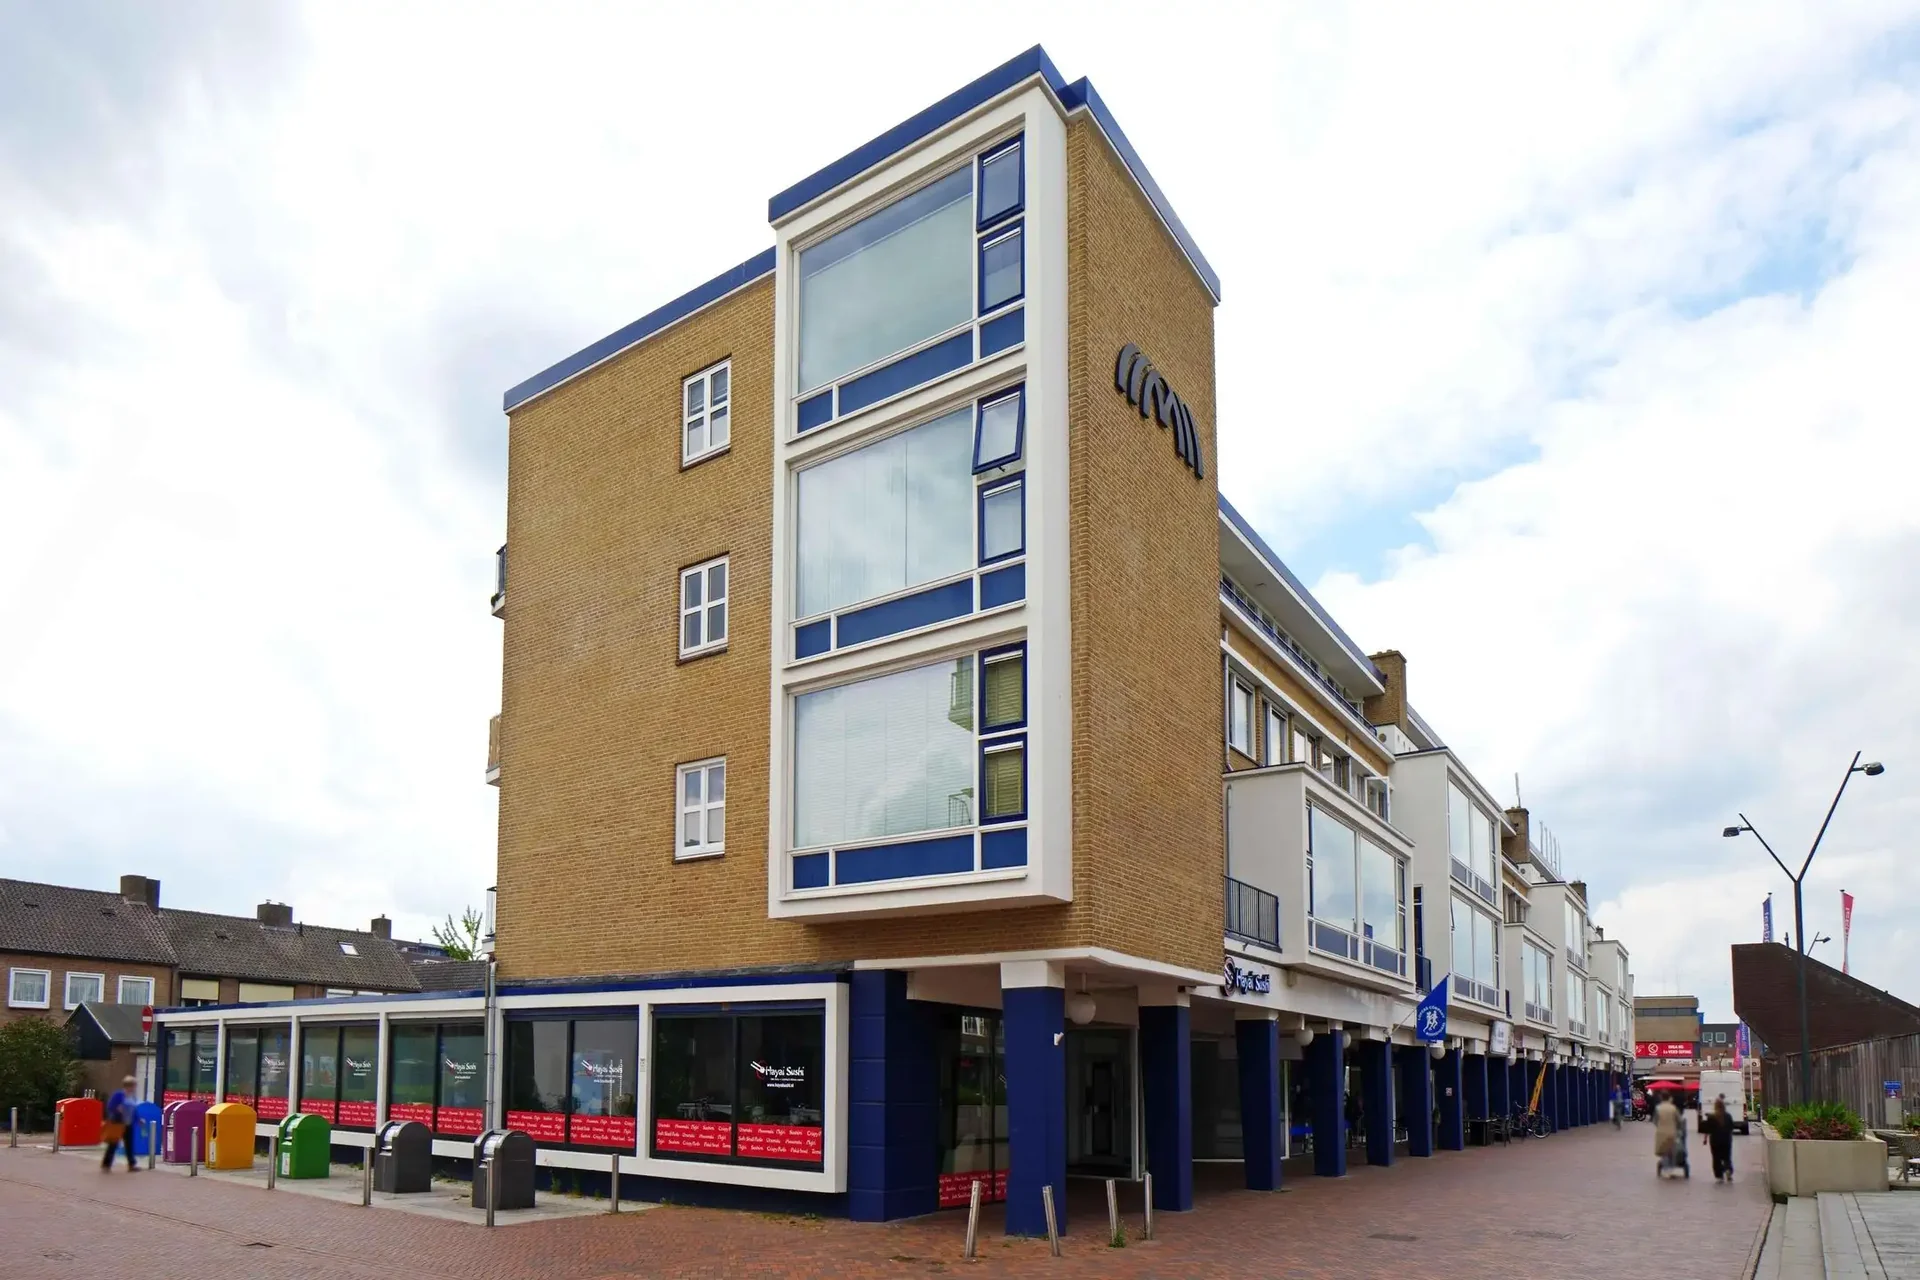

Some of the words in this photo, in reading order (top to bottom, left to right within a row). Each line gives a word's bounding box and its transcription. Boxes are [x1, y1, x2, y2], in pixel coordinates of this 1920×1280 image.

[1235, 967, 1254, 994] Hayai
[1254, 974, 1270, 993] Sushi
[765, 1065, 785, 1077] Hayai
[786, 1066, 805, 1076] Sushi
